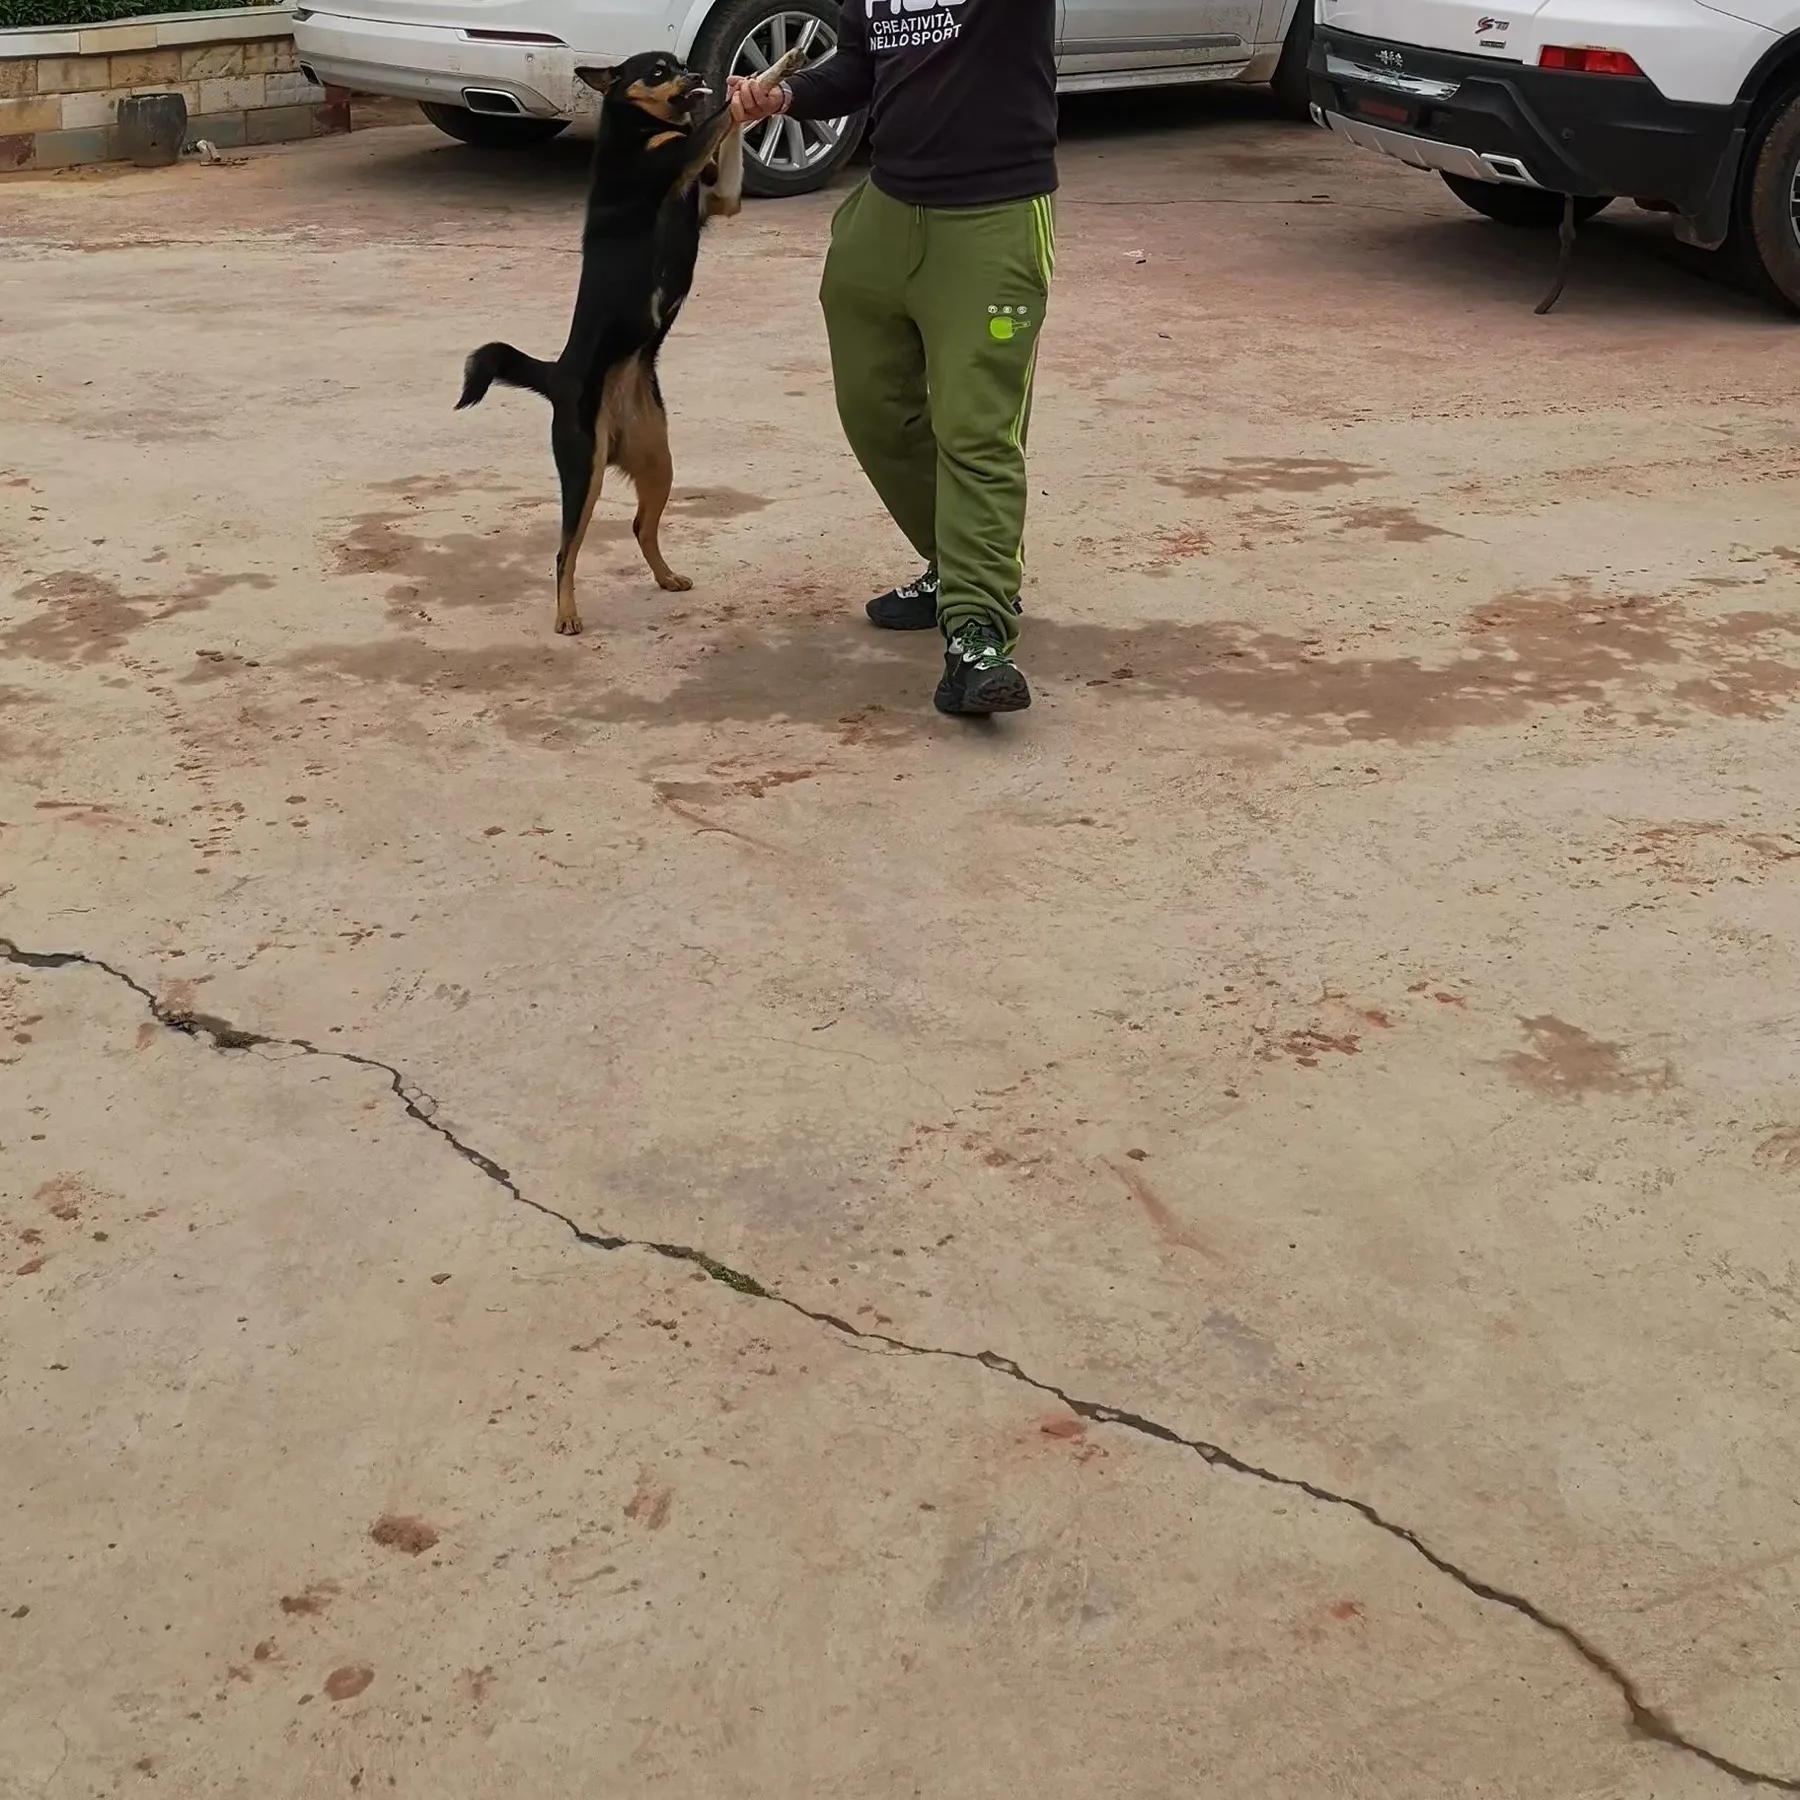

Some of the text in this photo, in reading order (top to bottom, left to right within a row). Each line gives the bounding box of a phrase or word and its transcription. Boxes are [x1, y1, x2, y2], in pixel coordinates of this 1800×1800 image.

[872, 7, 955, 35] CREATIVITÀ
[869, 23, 962, 51] NELLO SPORT
